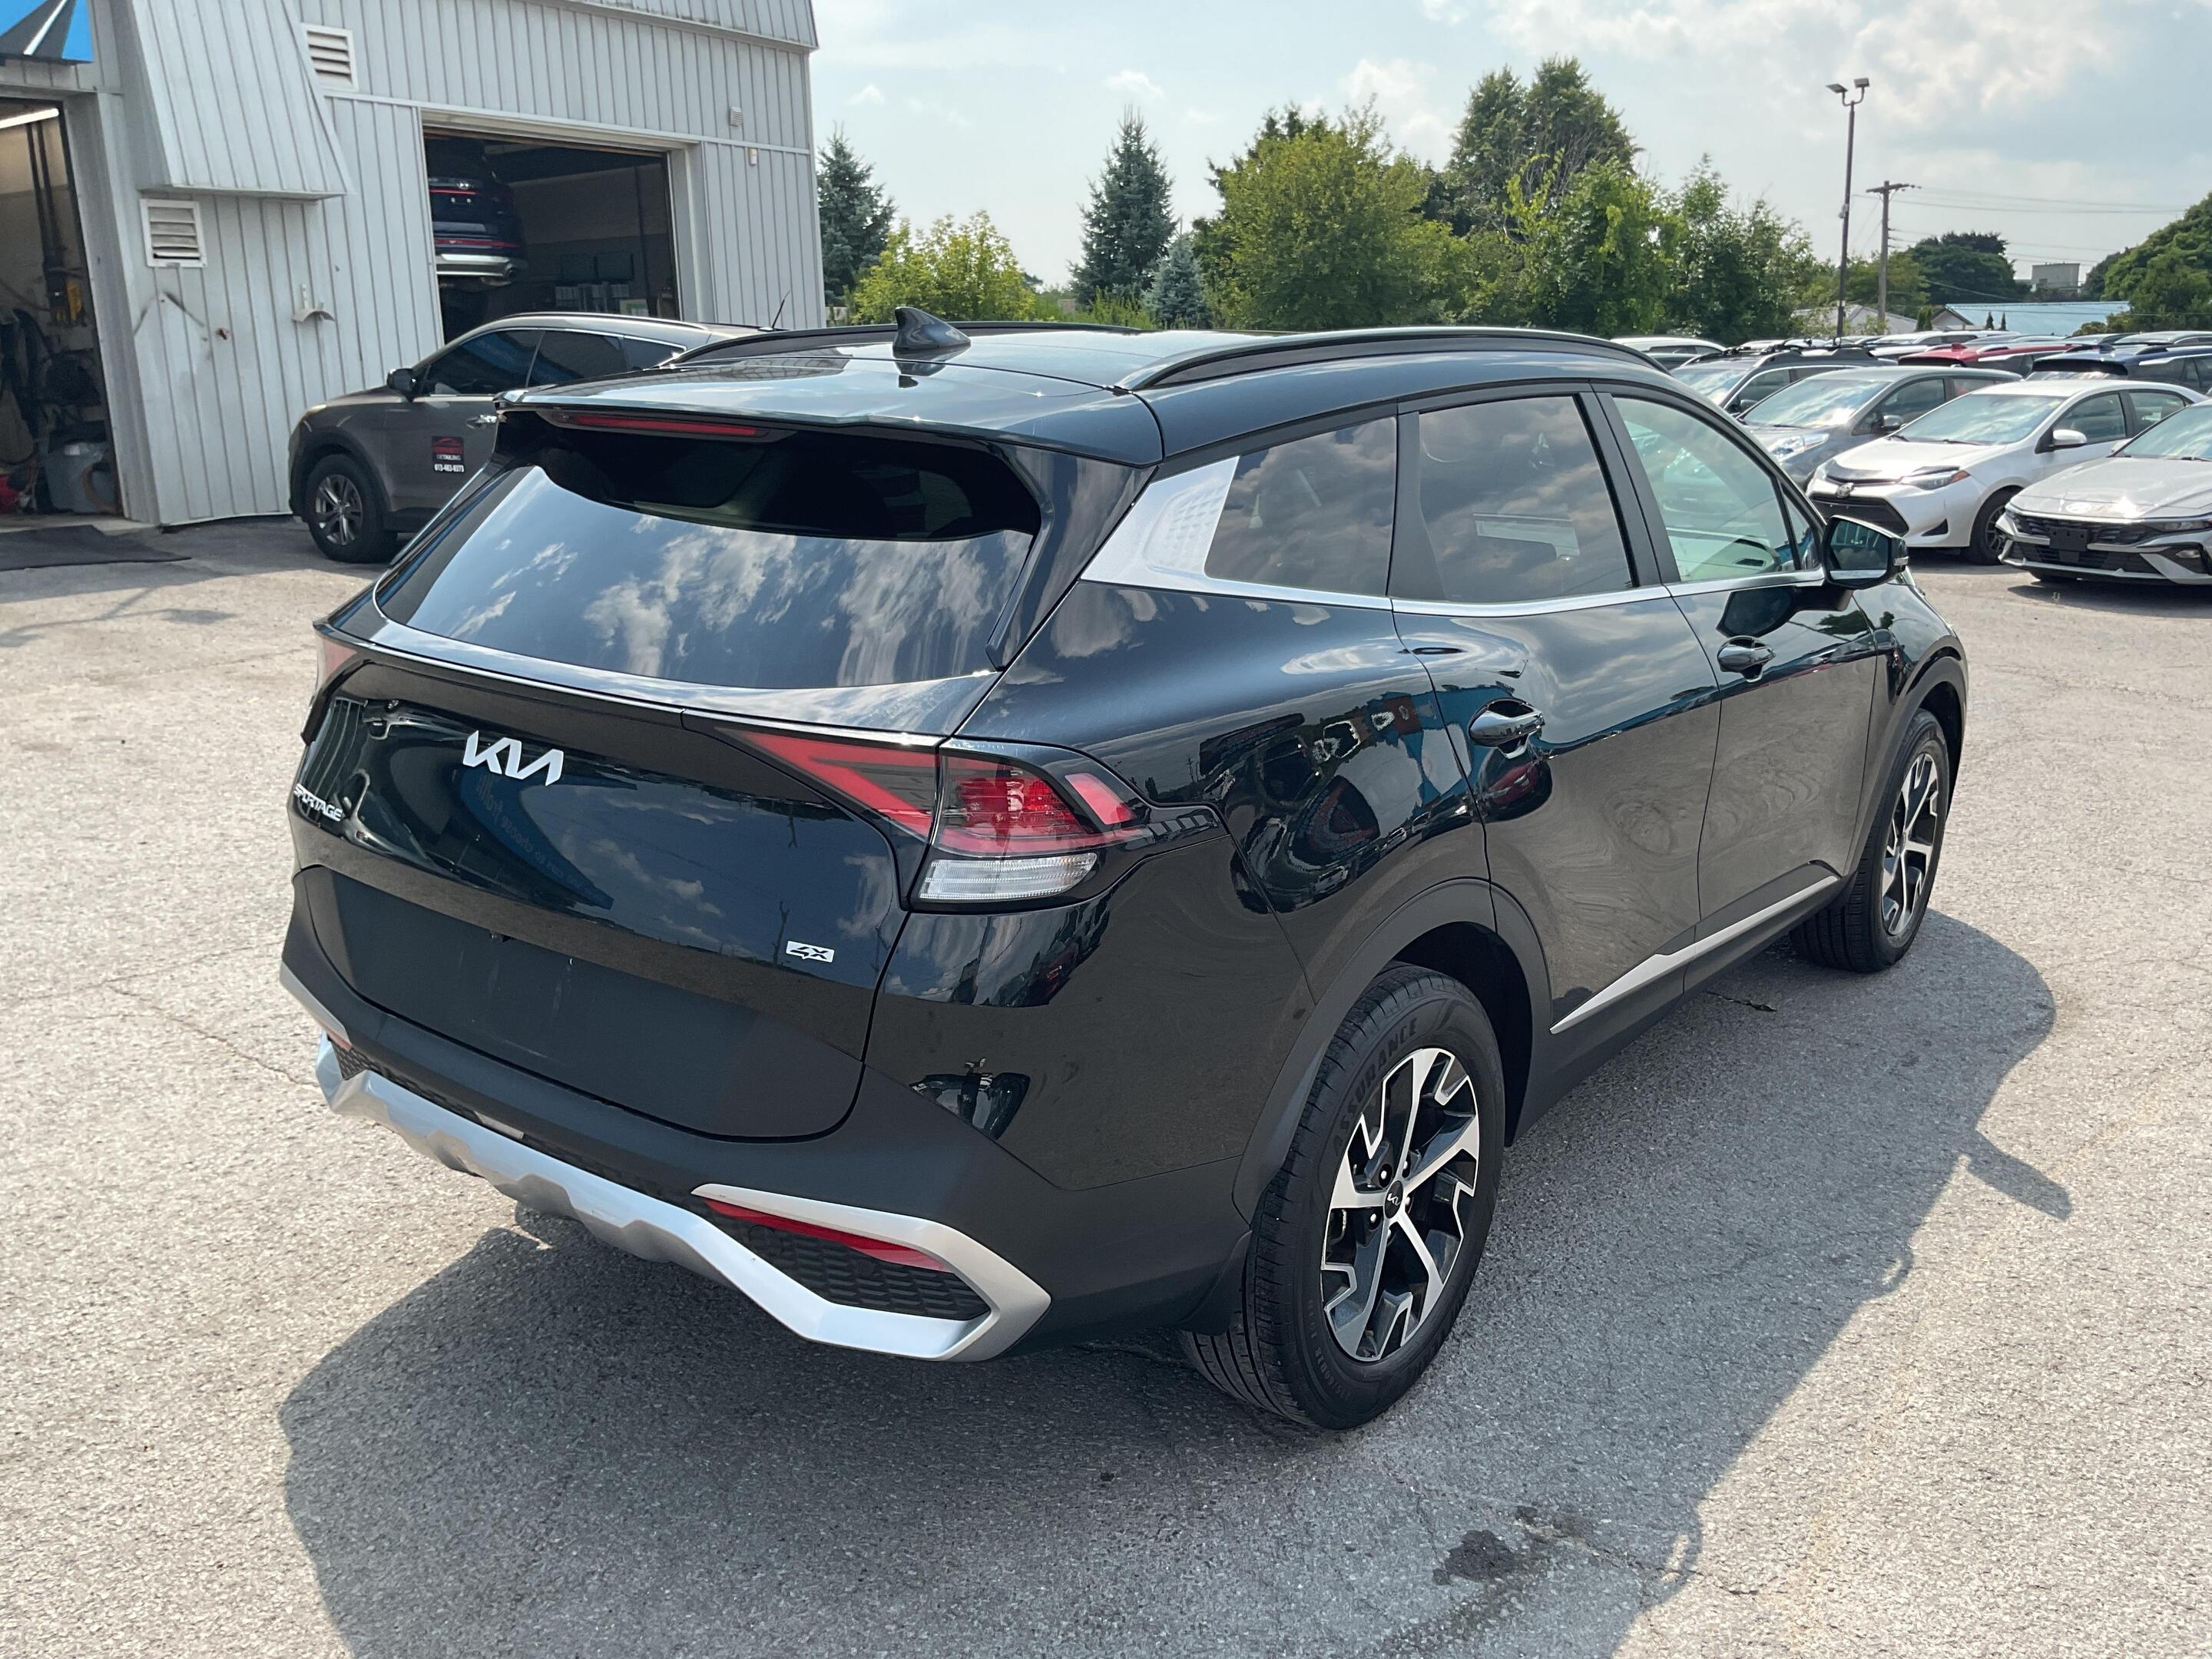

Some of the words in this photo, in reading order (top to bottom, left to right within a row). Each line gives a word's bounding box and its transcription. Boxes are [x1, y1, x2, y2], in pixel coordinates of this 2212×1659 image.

[462, 730, 565, 786] KIA
[293, 783, 343, 822] SPORTAGE
[1333, 1017, 1418, 1157] ASSURANCE
